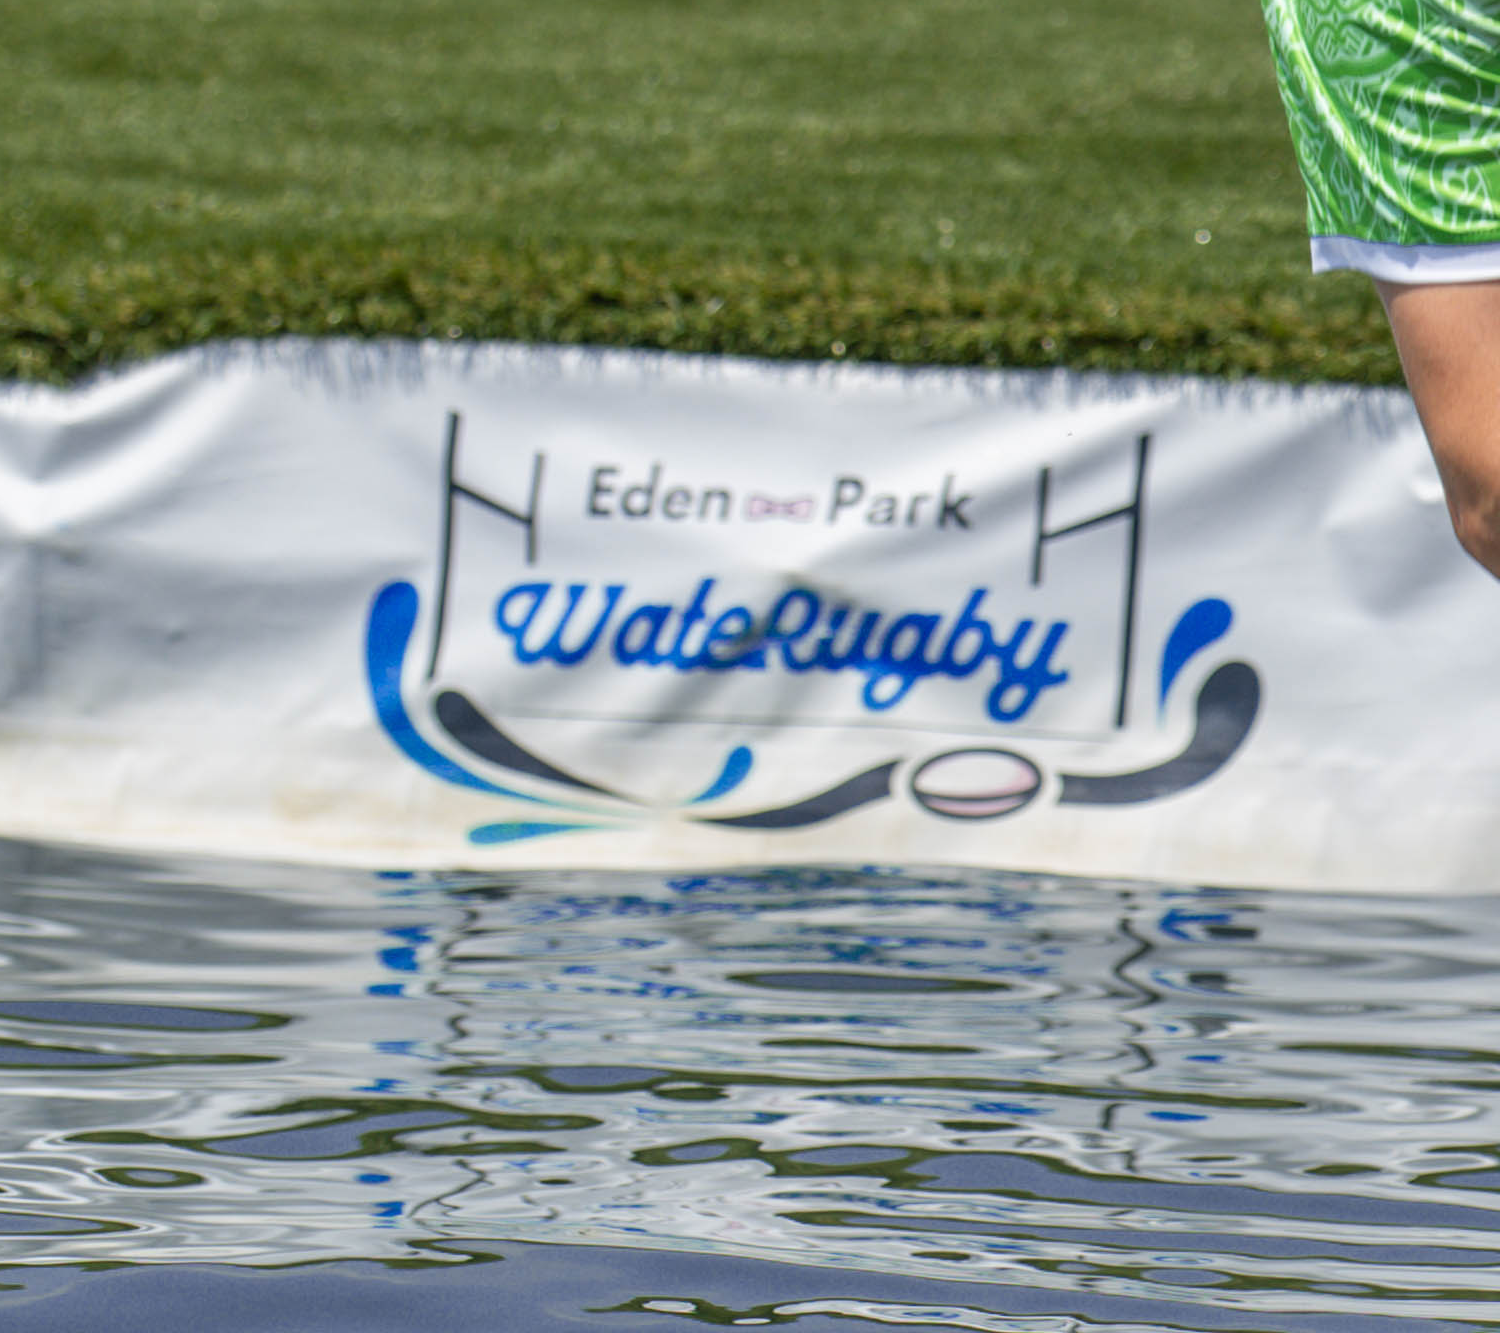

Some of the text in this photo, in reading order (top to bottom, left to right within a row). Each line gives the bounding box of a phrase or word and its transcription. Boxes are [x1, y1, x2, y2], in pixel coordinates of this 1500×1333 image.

[586, 463, 975, 532] Eden Park
[494, 576, 1070, 723] WateRugby
